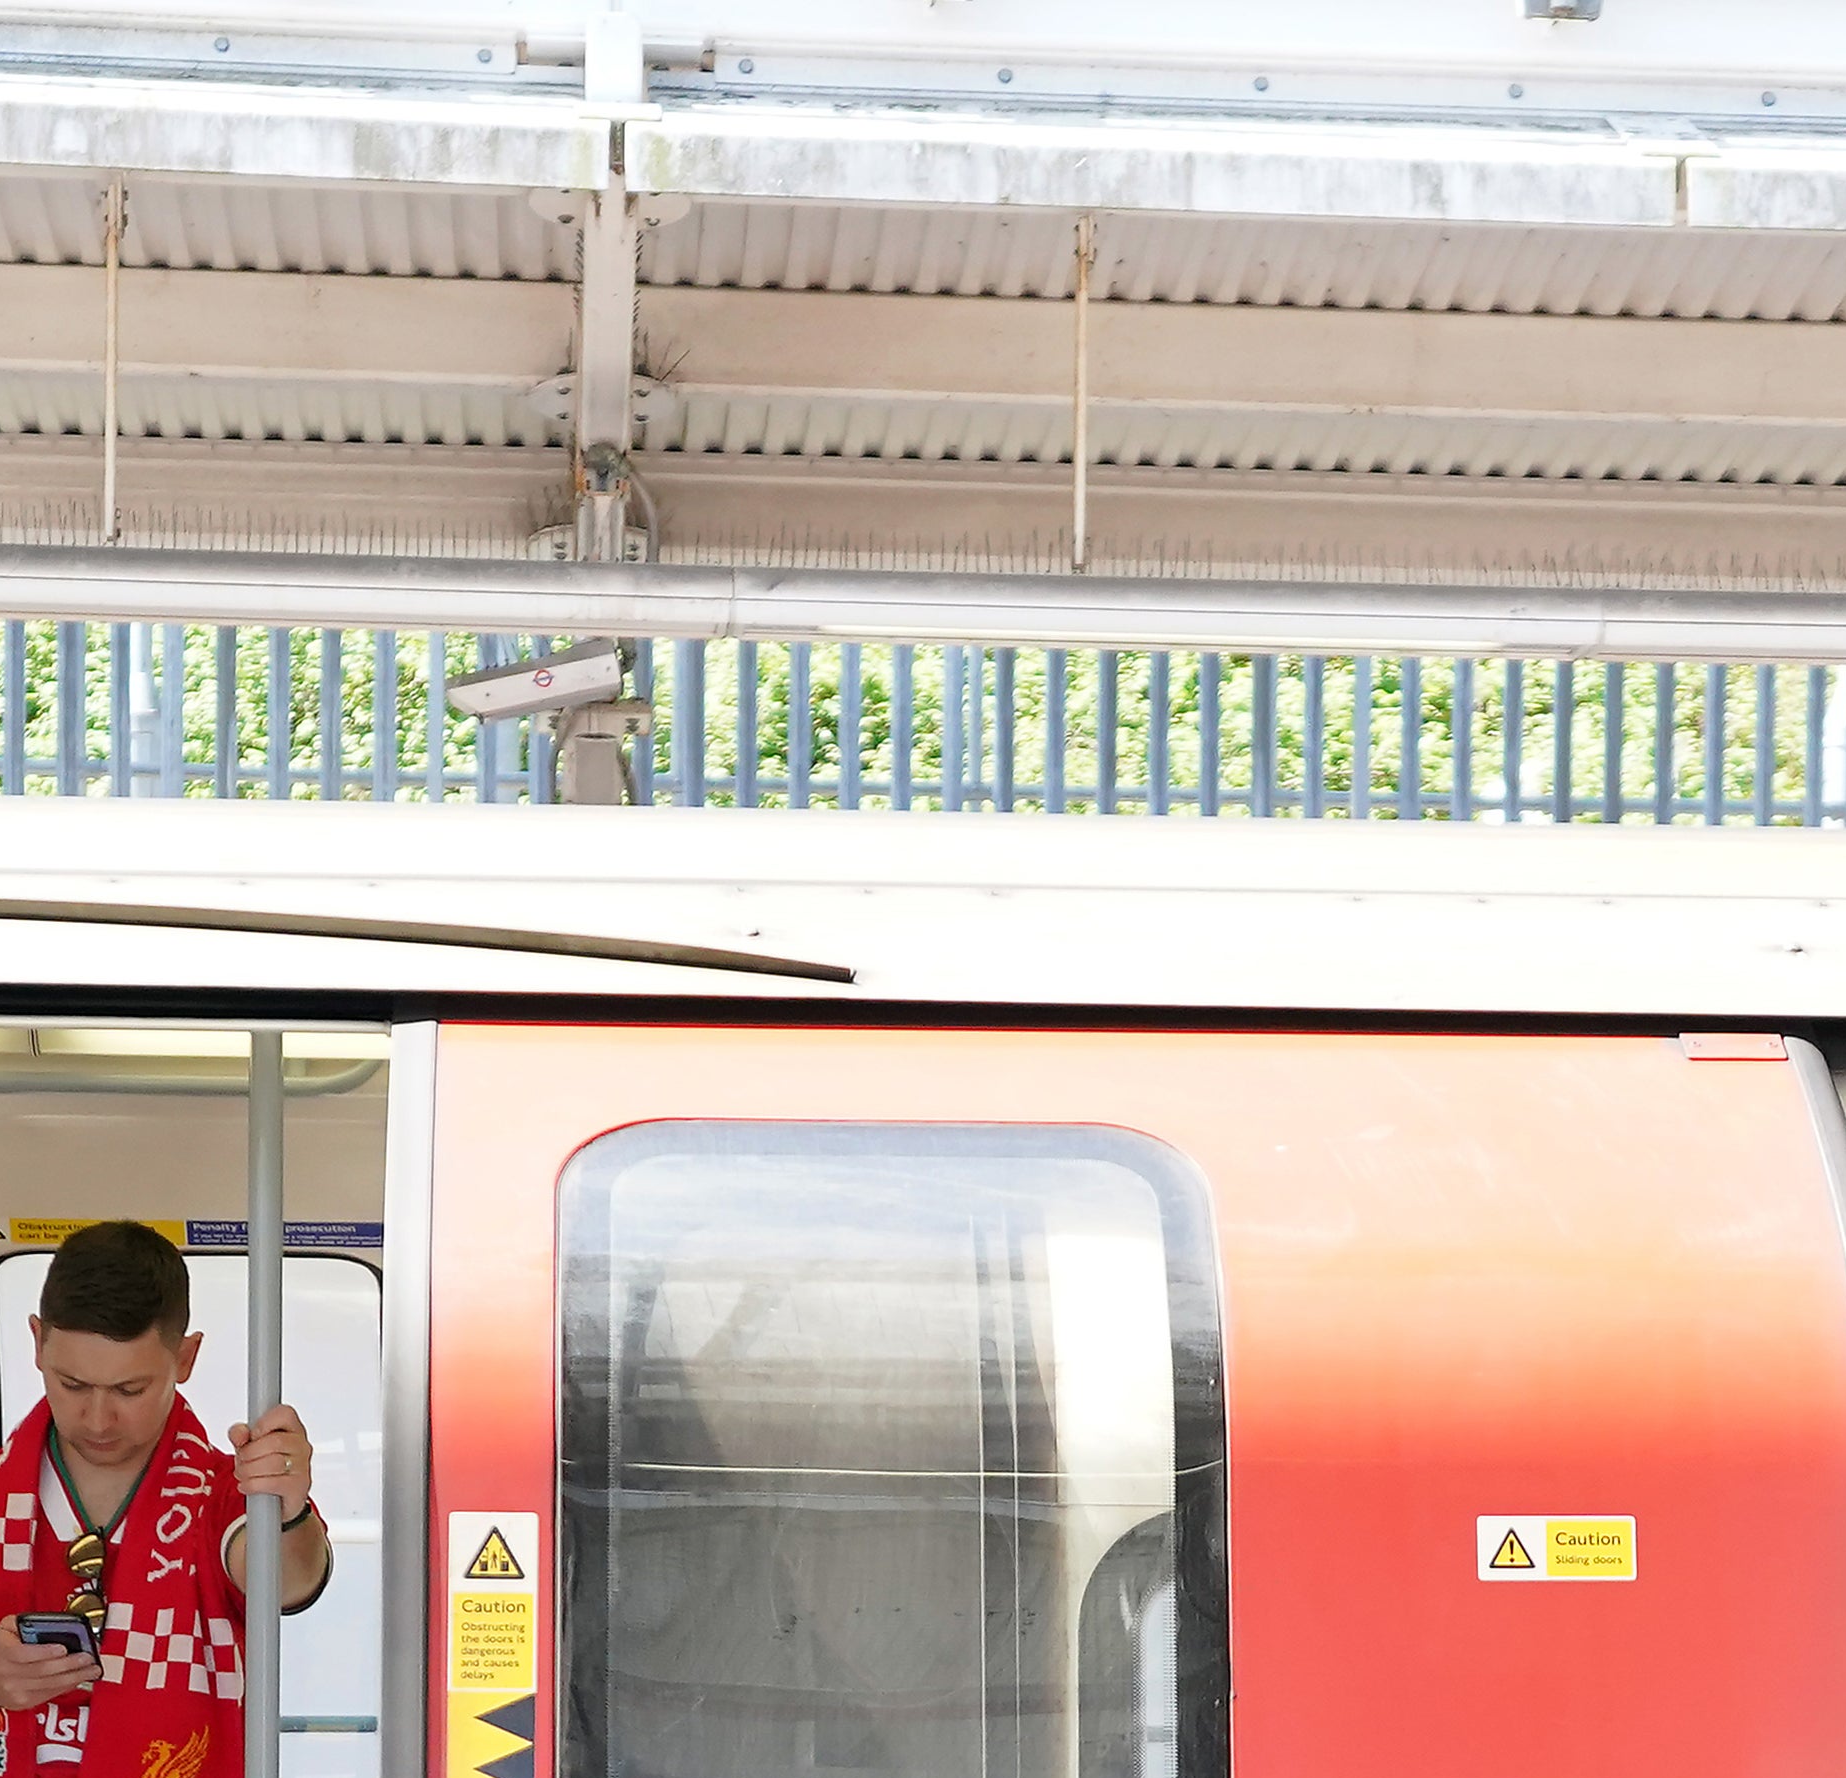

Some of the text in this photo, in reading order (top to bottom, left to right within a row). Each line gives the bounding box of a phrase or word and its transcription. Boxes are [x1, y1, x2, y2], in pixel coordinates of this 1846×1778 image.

[193, 1223, 237, 1232] Penalty
[285, 1224, 356, 1234] prosecution
[1555, 1531, 1621, 1546] Caution
[1555, 1555, 1622, 1566] Sliding doors
[461, 1599, 526, 1613] Caution
[461, 1622, 525, 1633] Obstructing
[461, 1635, 525, 1643] the doors is
[460, 1647, 515, 1657] dangerous
[460, 1659, 479, 1667] and
[460, 1671, 494, 1680] delays
